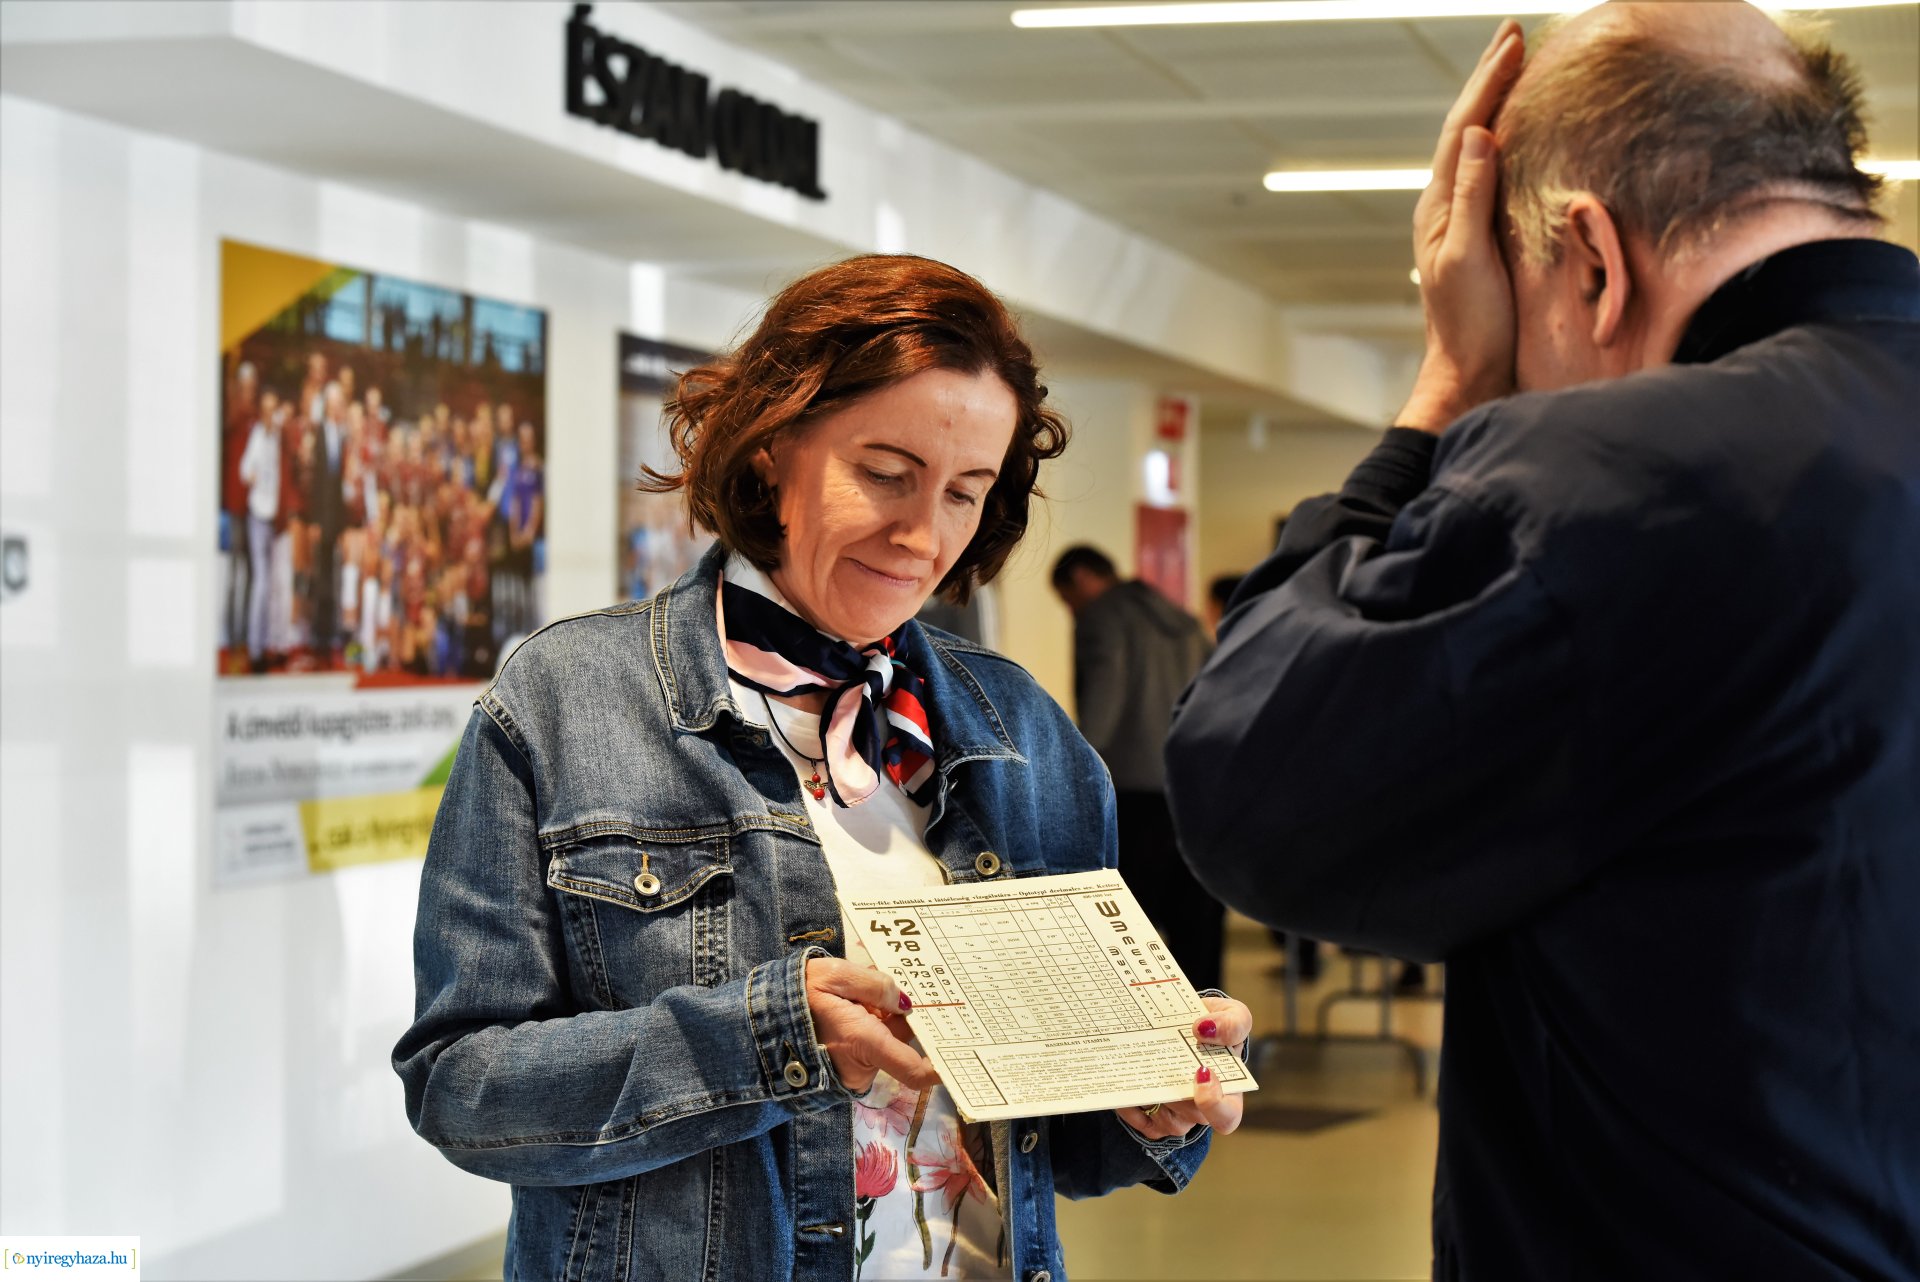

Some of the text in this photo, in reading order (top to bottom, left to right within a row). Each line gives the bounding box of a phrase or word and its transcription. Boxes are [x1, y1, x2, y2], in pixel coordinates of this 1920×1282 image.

[870, 919, 921, 936] 42
[887, 940, 920, 952] 78
[900, 957, 926, 967] 31
[909, 970, 931, 978] 73
